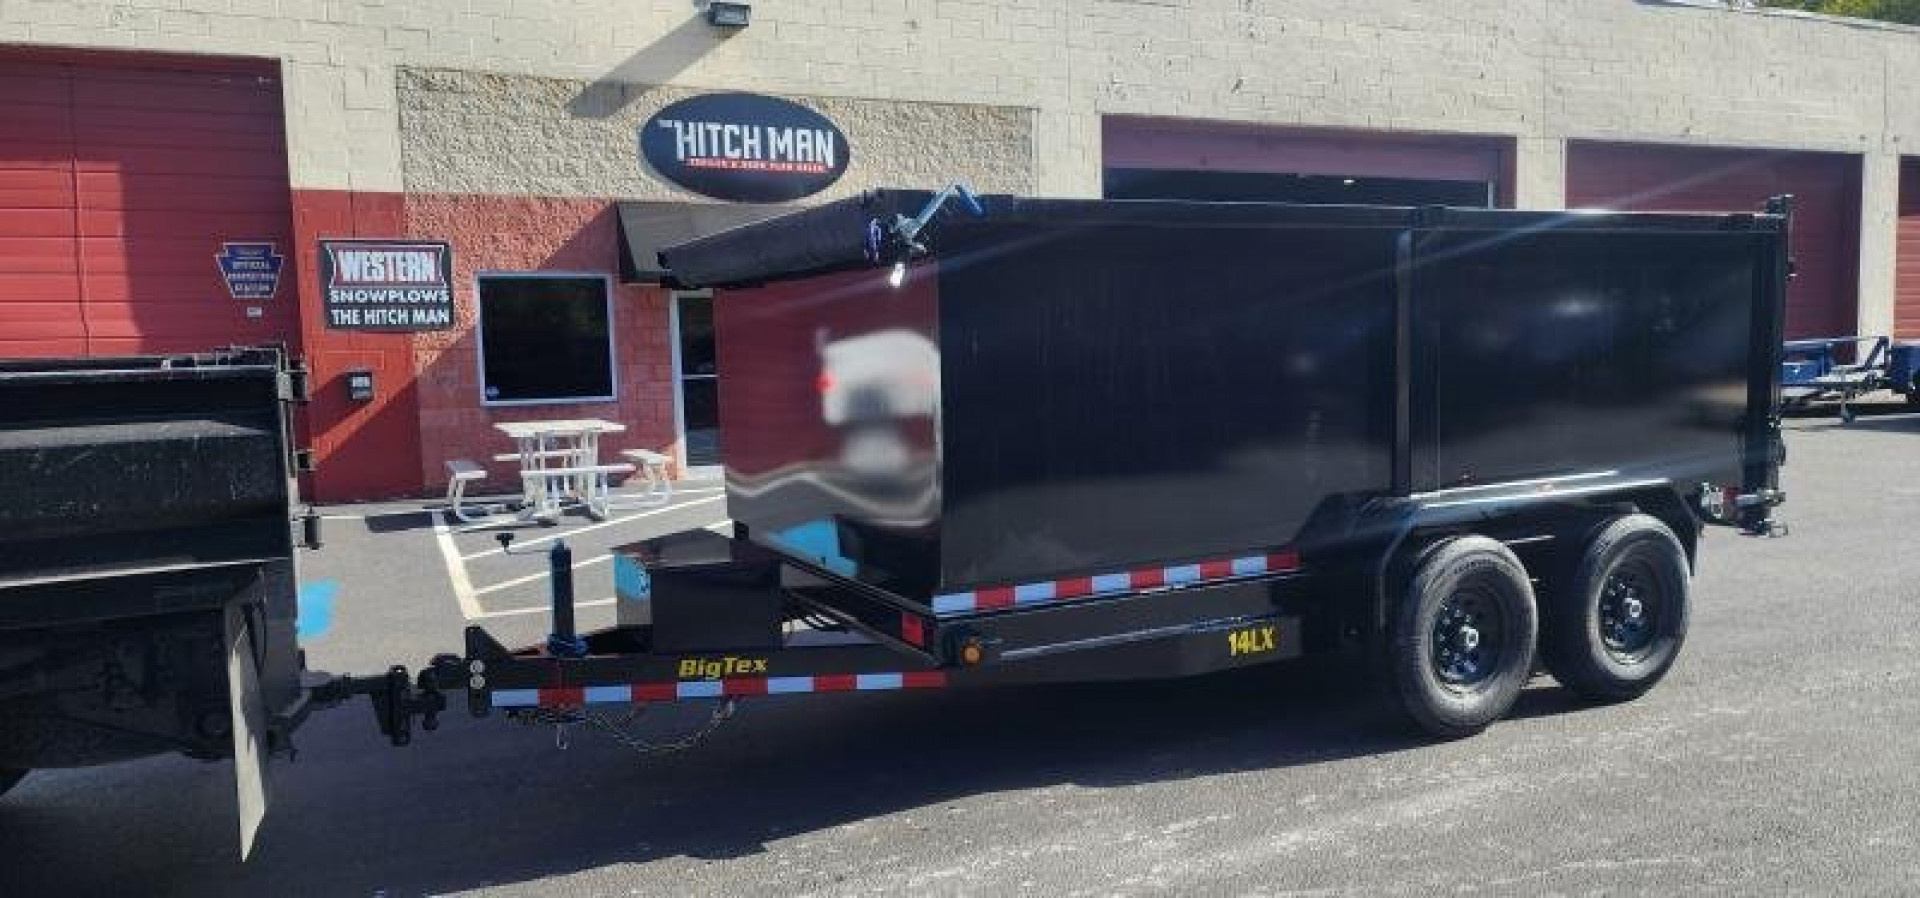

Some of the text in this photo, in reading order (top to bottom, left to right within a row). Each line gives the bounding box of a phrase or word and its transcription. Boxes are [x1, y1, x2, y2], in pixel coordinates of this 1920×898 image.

[674, 120, 762, 161] HITCH
[767, 126, 834, 169] MAN
[337, 249, 436, 282] WESTERN
[330, 289, 450, 304] SNOWPLOWS
[330, 309, 450, 325] THE HITCH MAN
[1228, 628, 1275, 656] 14LX
